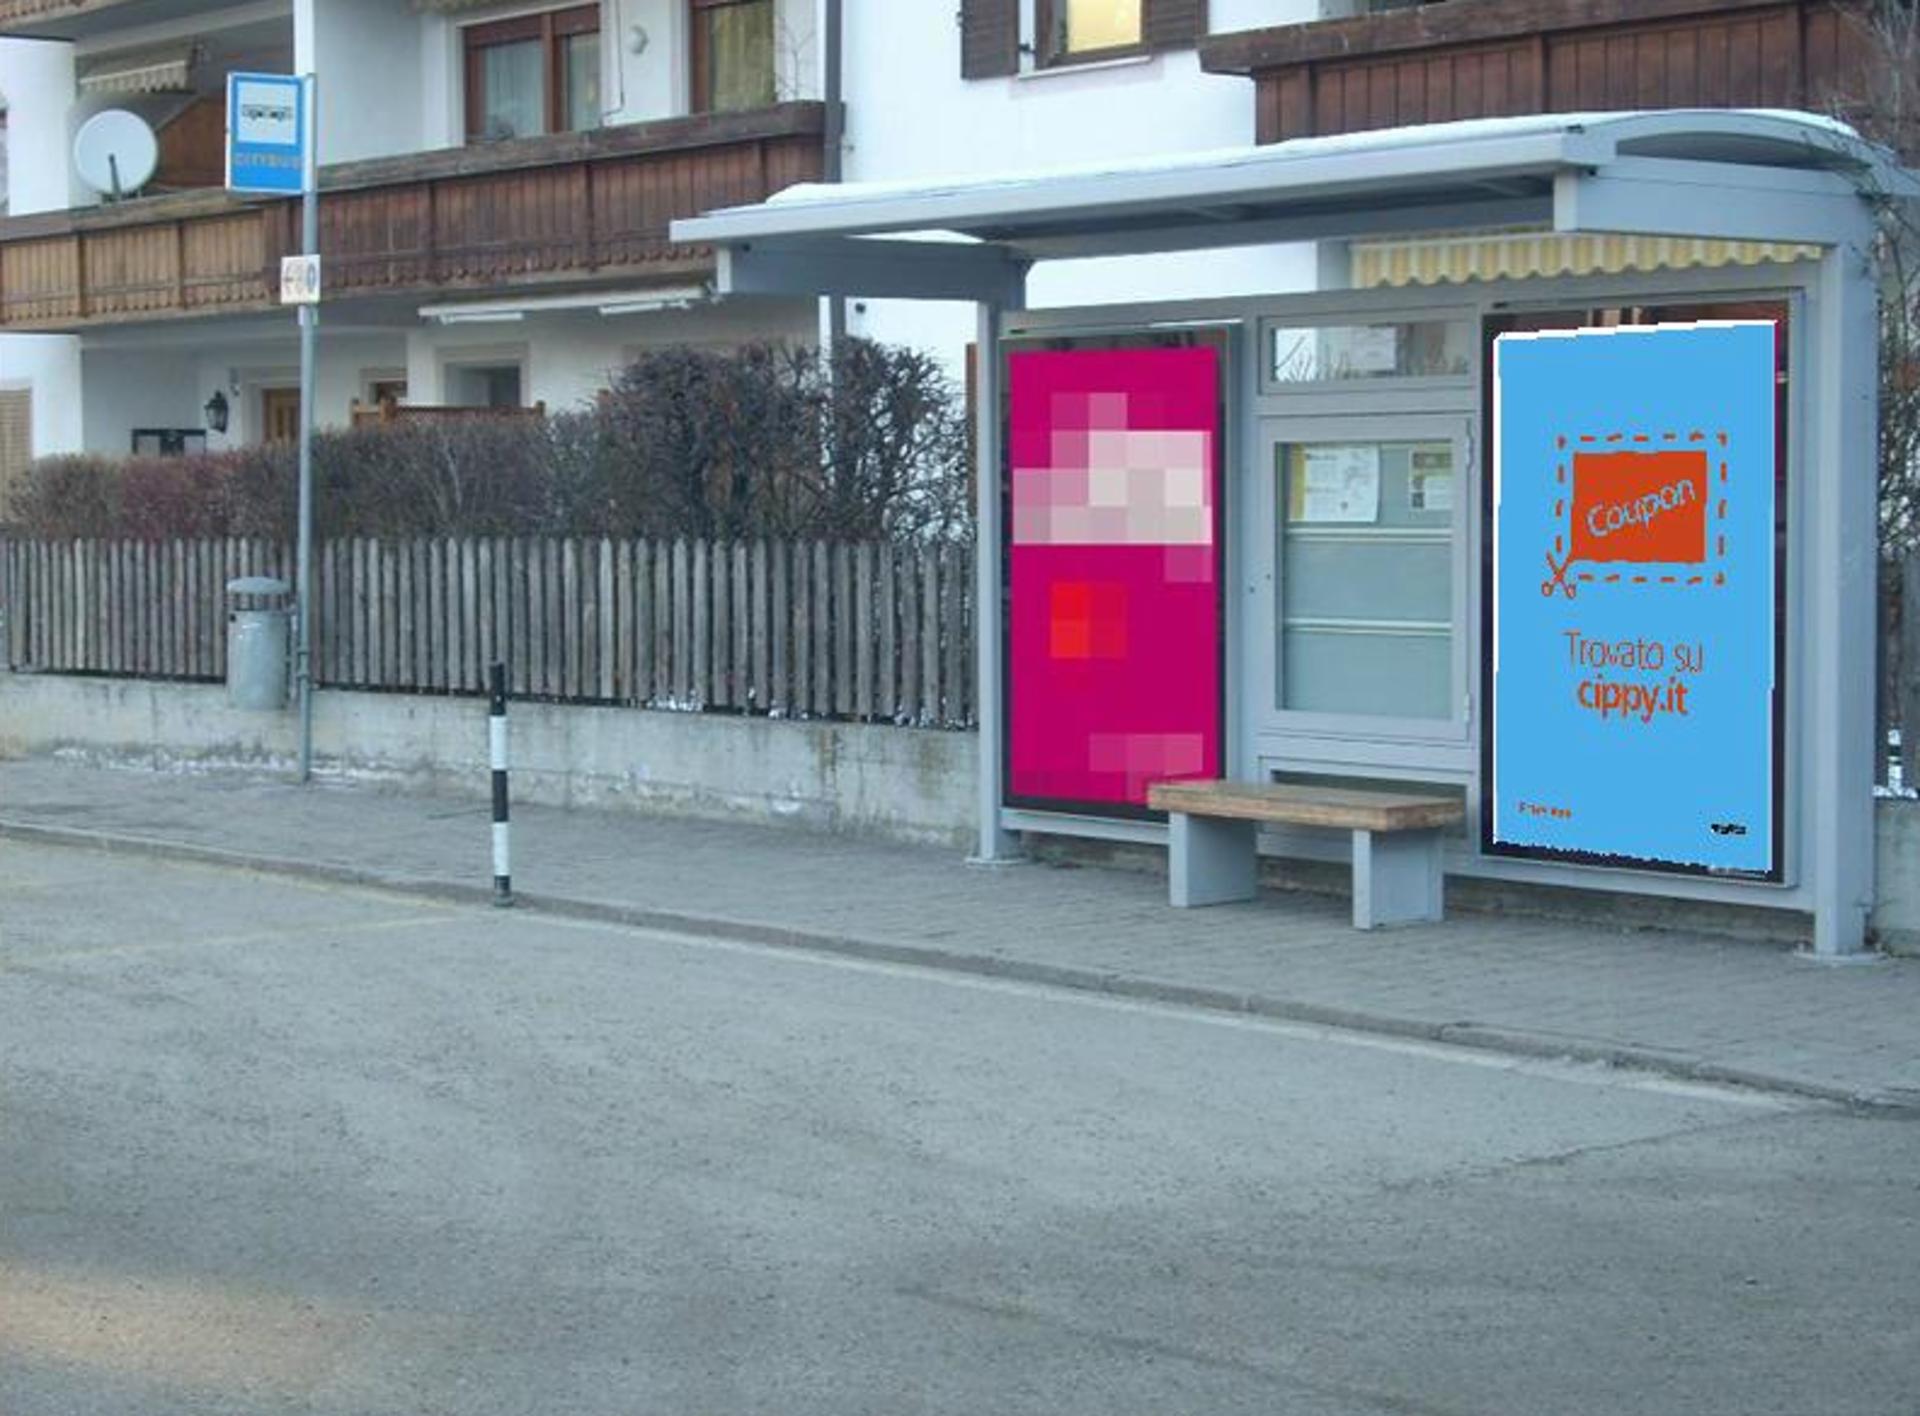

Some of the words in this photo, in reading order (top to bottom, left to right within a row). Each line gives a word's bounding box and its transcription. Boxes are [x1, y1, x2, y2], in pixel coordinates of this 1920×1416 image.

[1586, 479, 1696, 537] Coupon
[1564, 630, 1664, 670] Trovato
[1673, 641, 1704, 673] su
[1578, 674, 1688, 723] cippy.it
